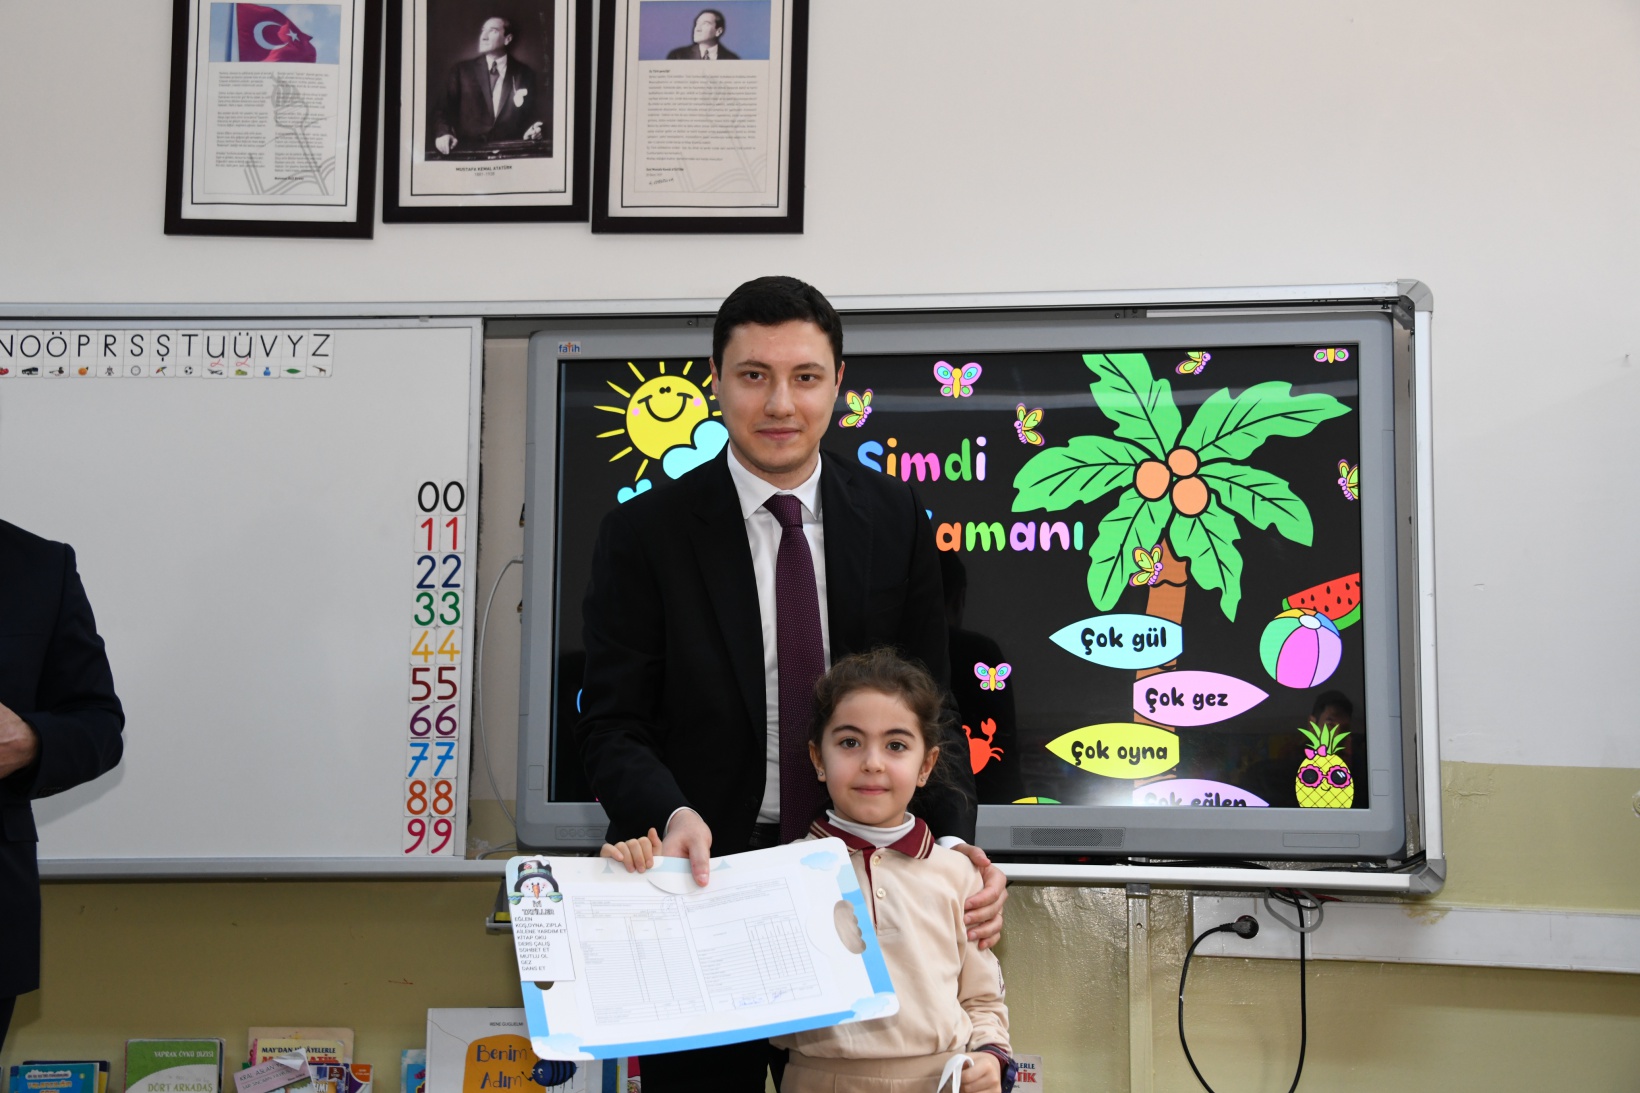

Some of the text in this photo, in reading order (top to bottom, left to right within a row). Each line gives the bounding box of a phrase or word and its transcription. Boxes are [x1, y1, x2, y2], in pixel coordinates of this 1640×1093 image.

[558, 342, 580, 353] fatih
[926, 509, 1084, 552] amanı
[1081, 627, 1167, 655] Çok gül
[1145, 687, 1228, 713] Çok gez
[1071, 740, 1168, 766] Çok oyna
[476, 1044, 527, 1063] Benim
[480, 1071, 522, 1090] Adım
[1017, 1069, 1037, 1083] TİK
[148, 1082, 213, 1093] DÖRT ARKADAŞ
